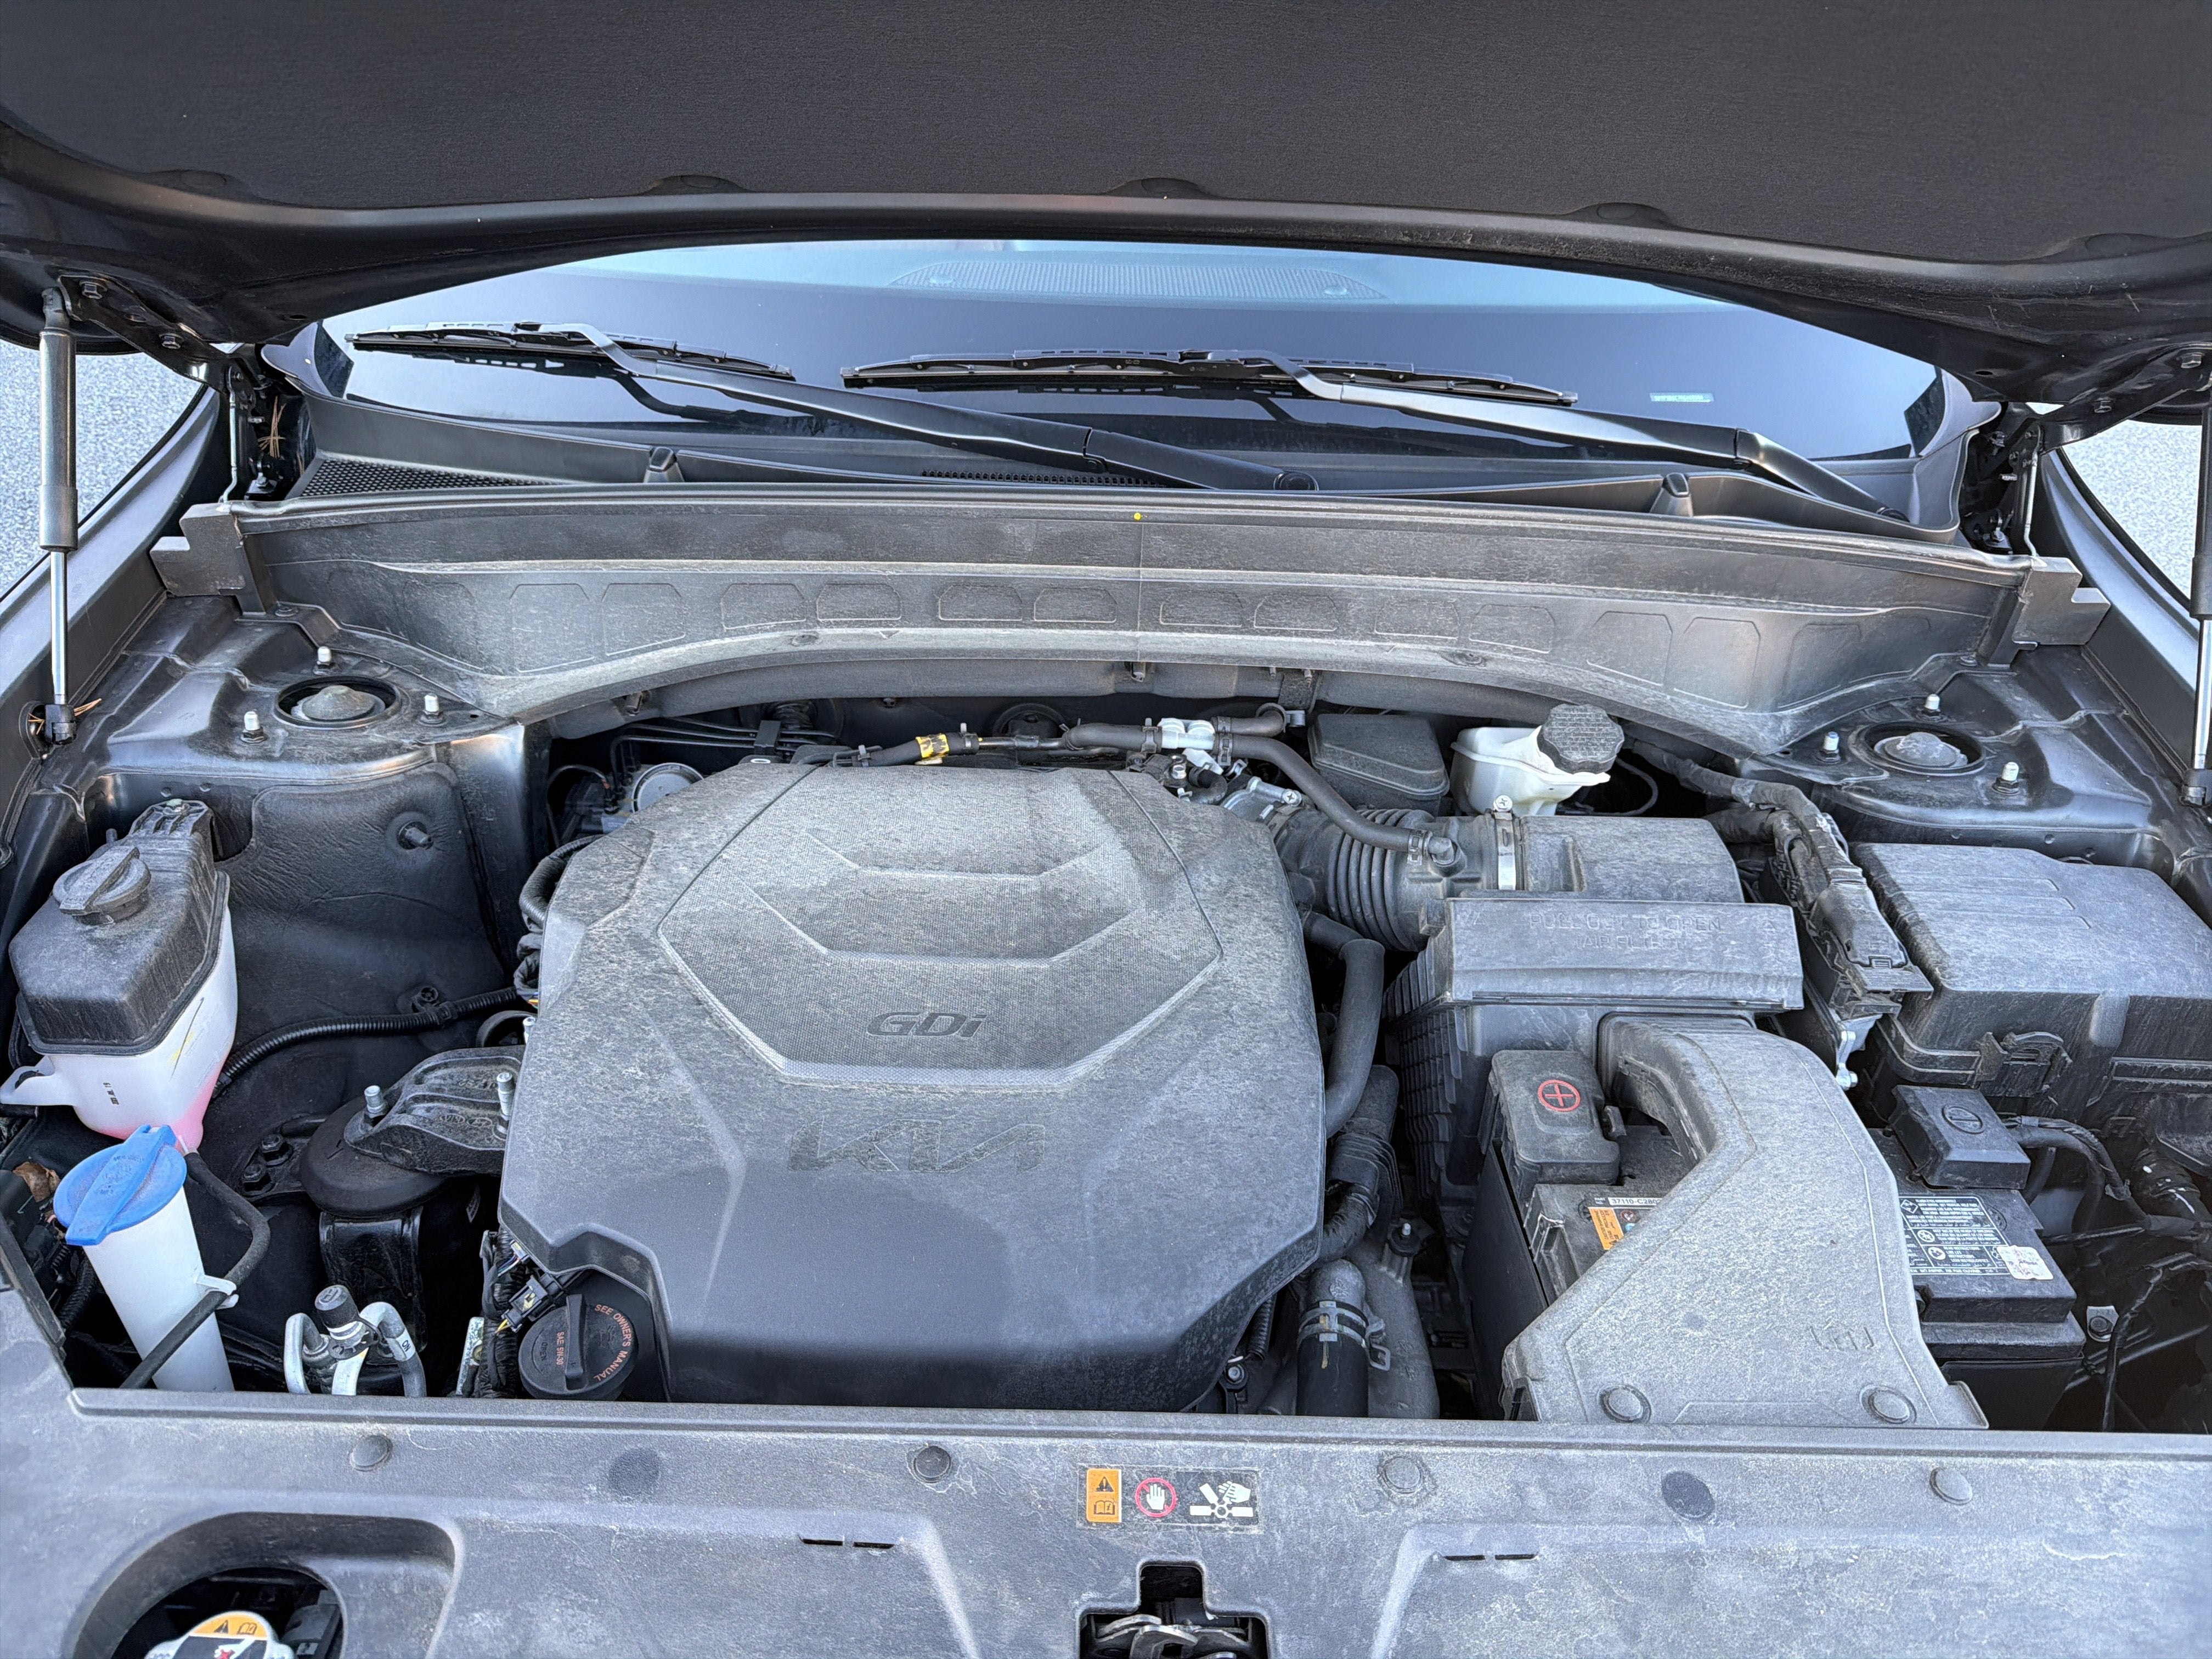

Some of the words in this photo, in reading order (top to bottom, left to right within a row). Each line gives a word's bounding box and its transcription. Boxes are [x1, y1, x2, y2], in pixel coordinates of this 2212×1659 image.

[866, 1012, 988, 1038] GDi
[788, 1117, 1046, 1173] KIA
[594, 1304, 614, 1316] SEE
[556, 1331, 565, 1345] SAE
[613, 1313, 633, 1347] OWNER'S
[556, 1347, 564, 1365] 5W-30
[593, 1350, 628, 1381] MANUAL
